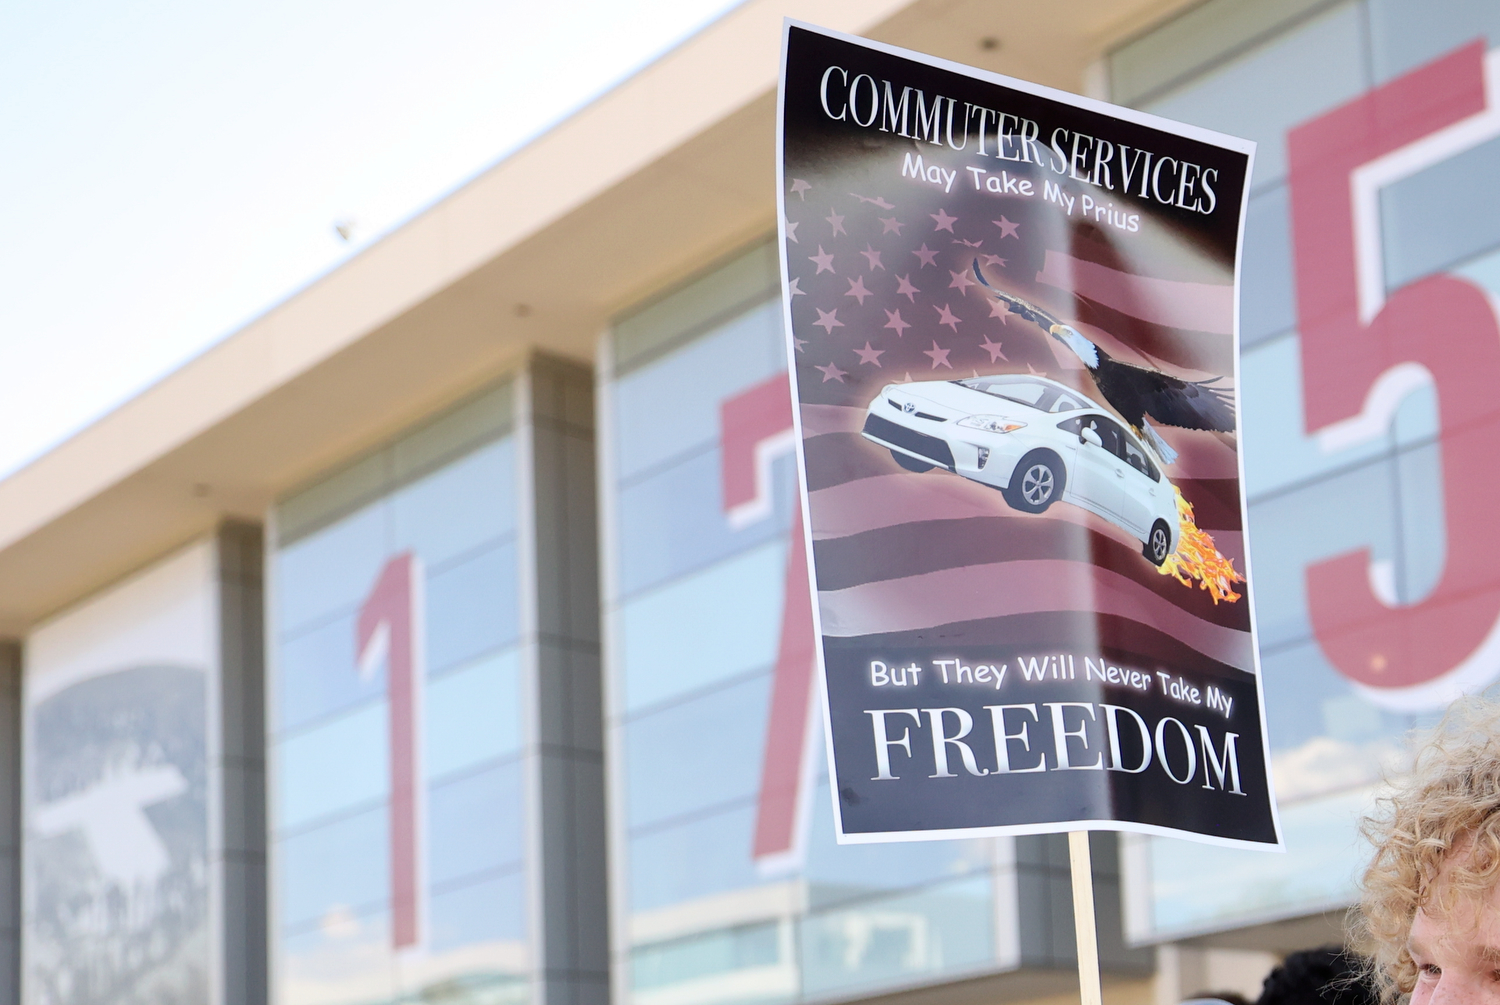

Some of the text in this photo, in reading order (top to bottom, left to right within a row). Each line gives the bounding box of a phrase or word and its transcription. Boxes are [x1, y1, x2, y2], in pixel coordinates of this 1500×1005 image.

[819, 65, 1219, 215] COMMUTER SERVICES
[901, 152, 1141, 234] May Take My Prius
[869, 653, 1235, 719] But They Will Never Take My
[862, 701, 1249, 797] FREEDOM
